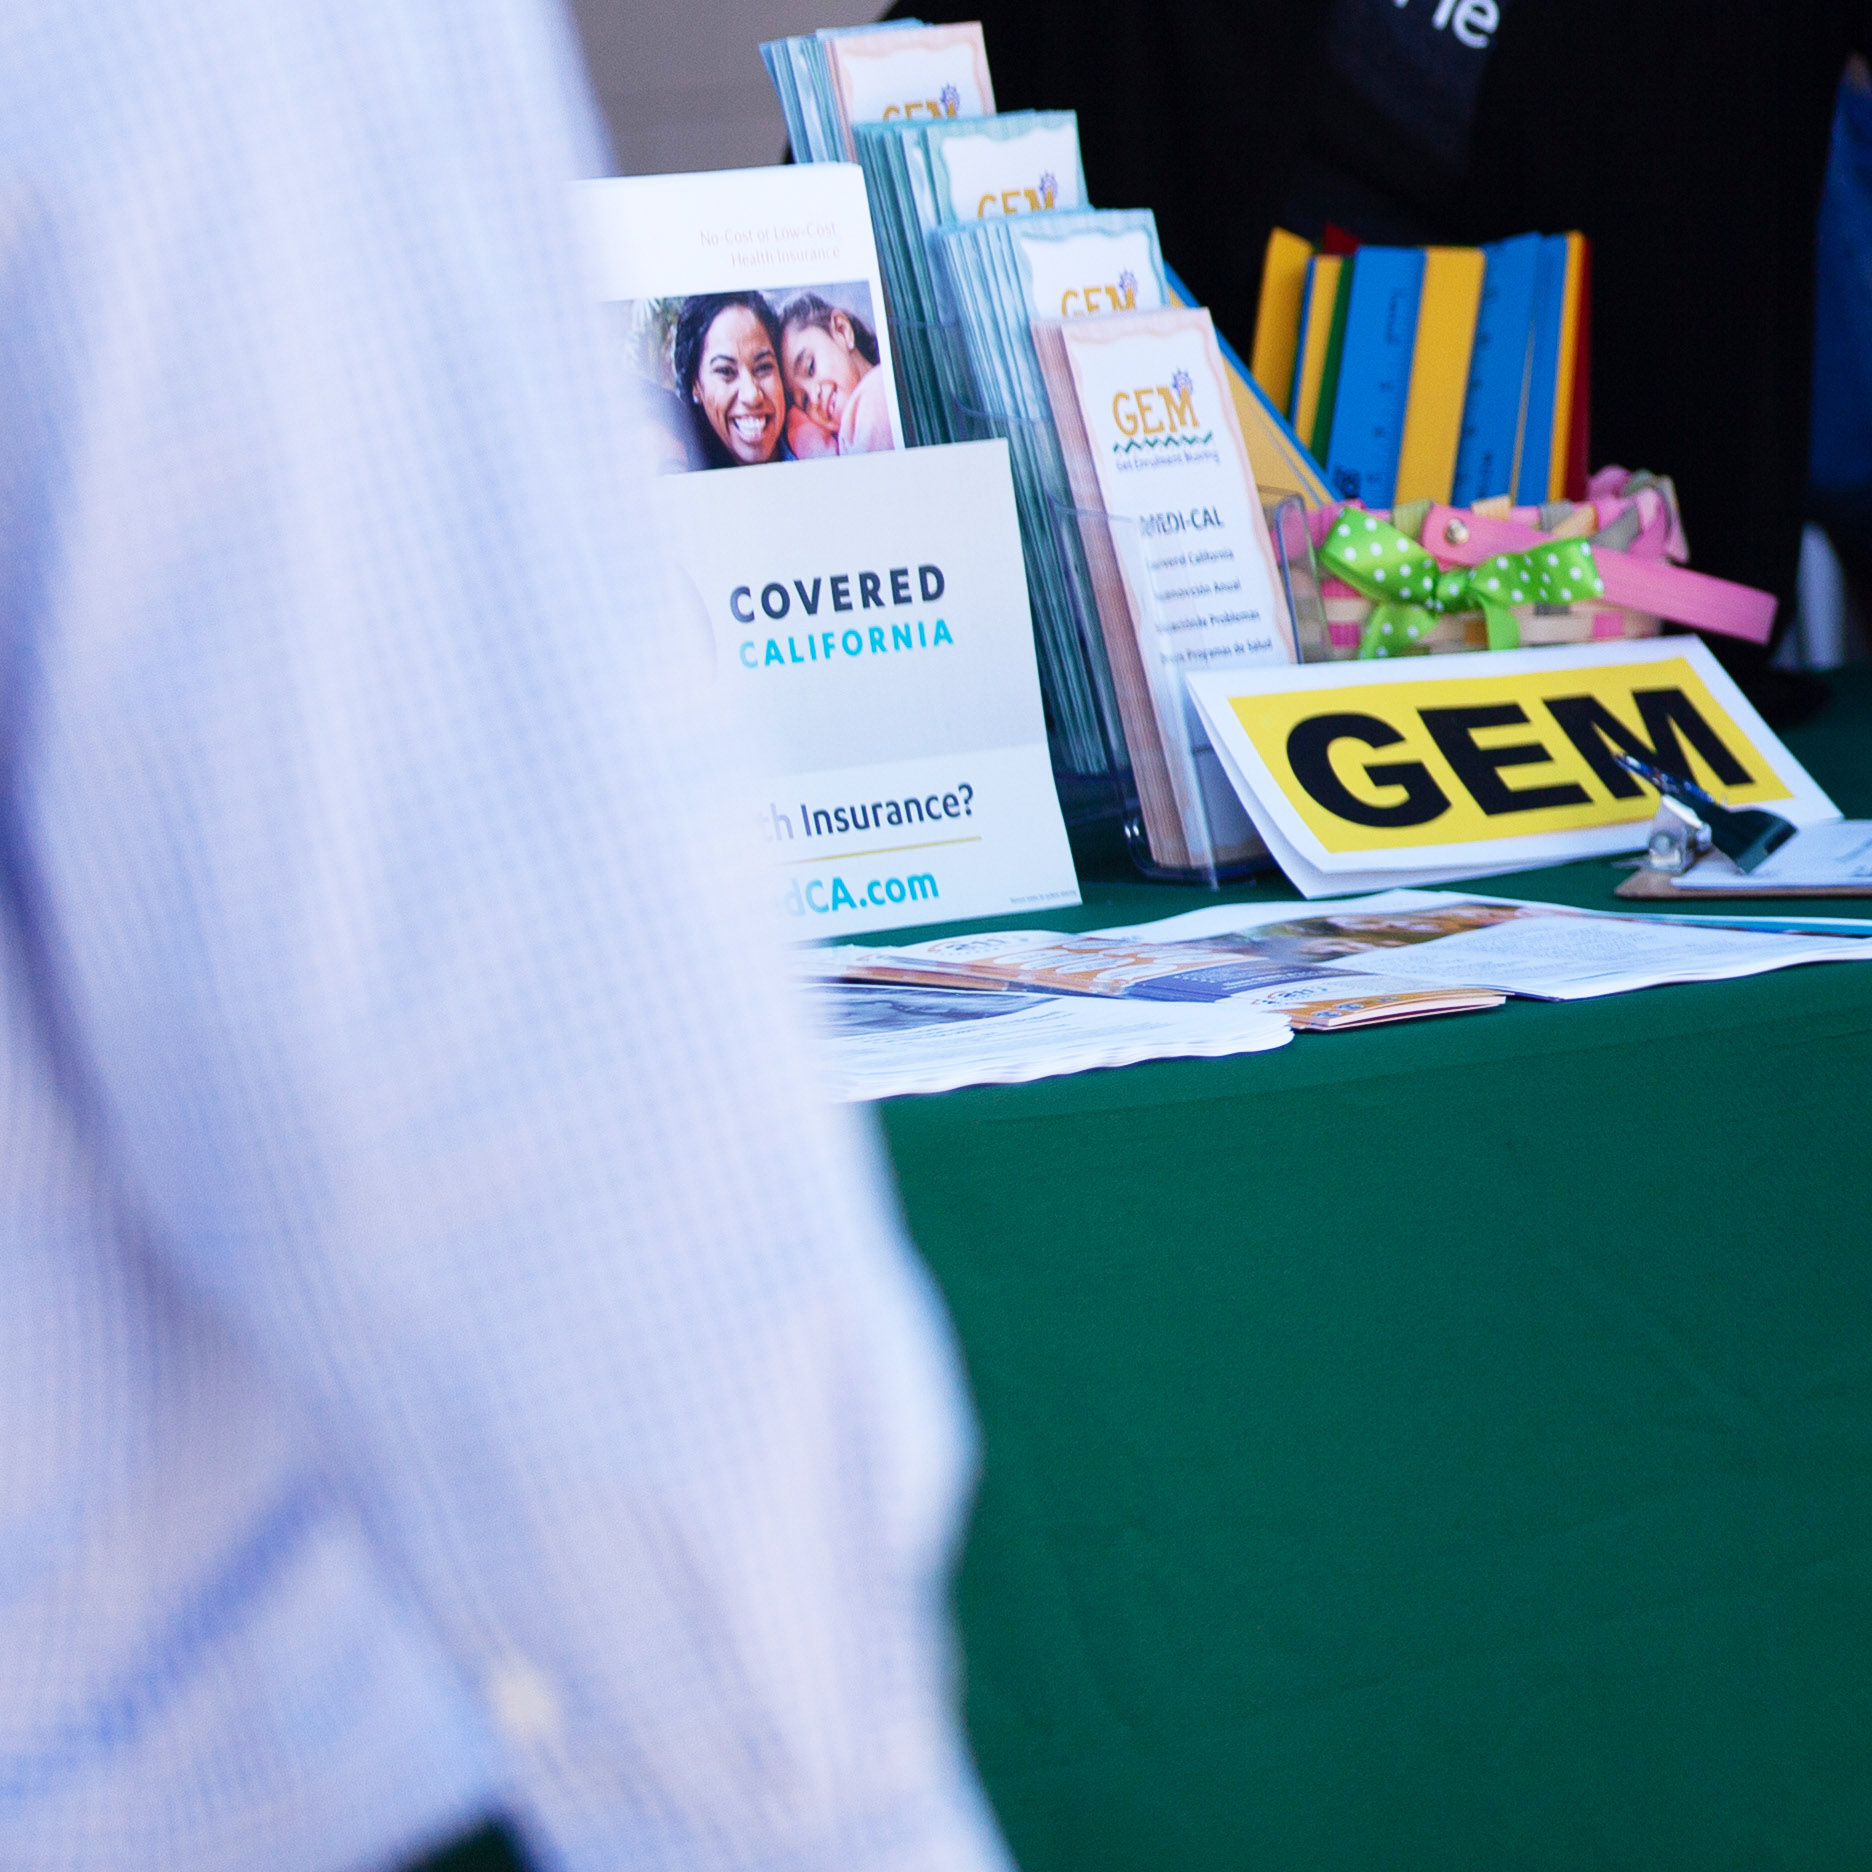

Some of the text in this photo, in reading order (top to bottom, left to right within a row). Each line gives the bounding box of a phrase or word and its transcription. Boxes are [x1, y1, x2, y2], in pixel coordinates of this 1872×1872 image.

[730, 245, 841, 269] Health Insurance
[1112, 384, 1200, 438] GEM
[1139, 505, 1224, 538] MEDI-CAL
[730, 563, 947, 626] COVERED
[739, 618, 955, 670] CALIFORNIA
[1285, 685, 1756, 829] GEM
[801, 781, 974, 838] Insurance?
